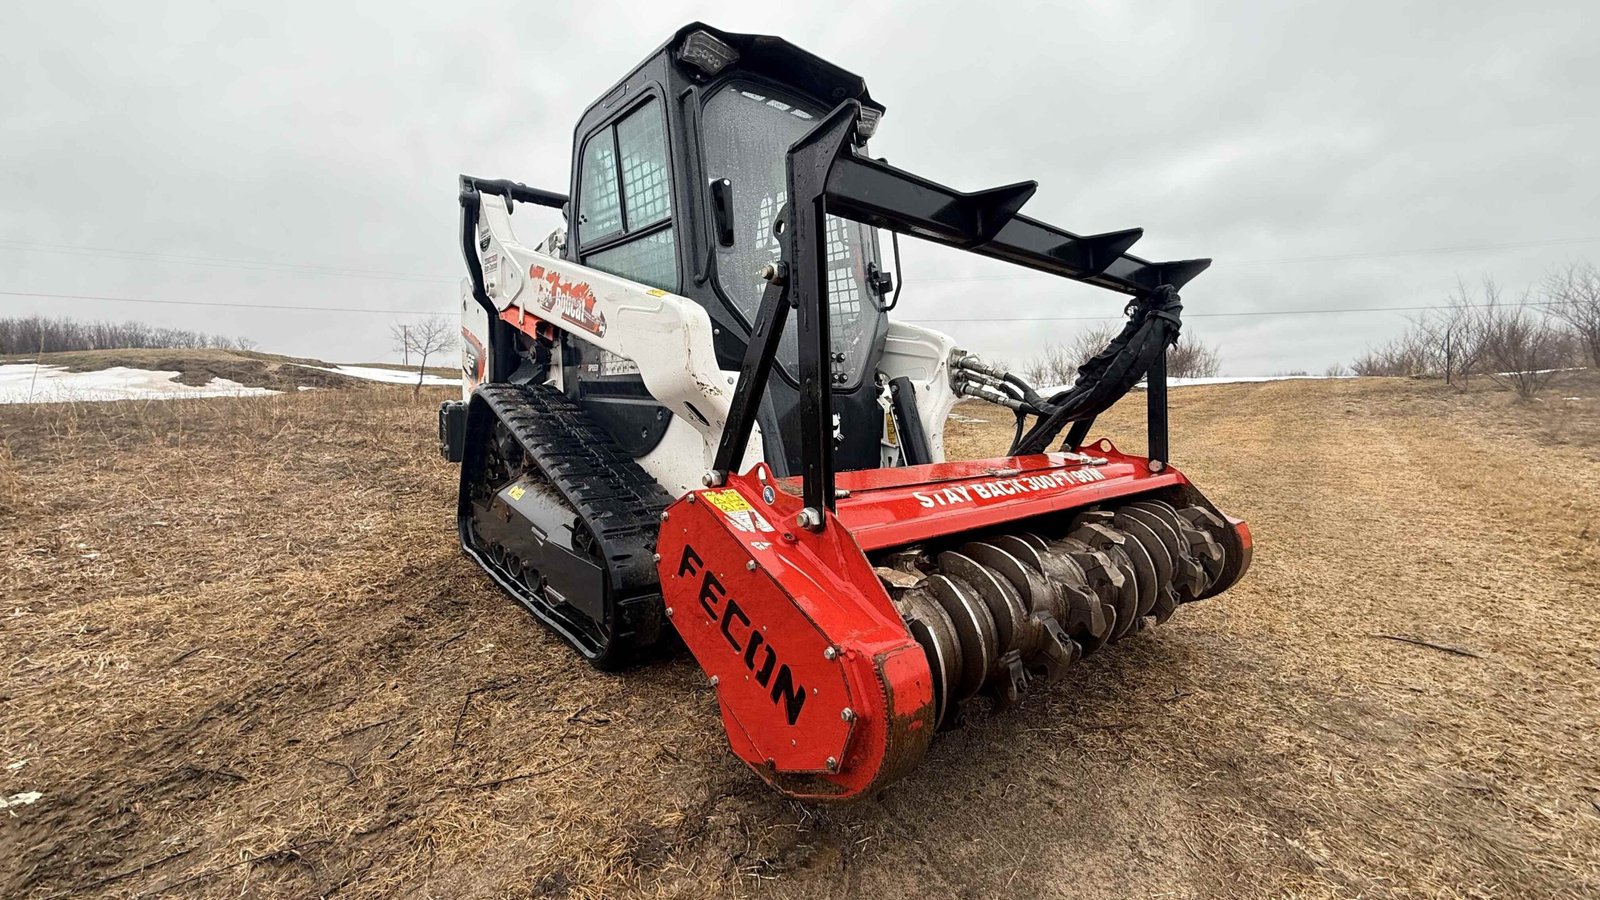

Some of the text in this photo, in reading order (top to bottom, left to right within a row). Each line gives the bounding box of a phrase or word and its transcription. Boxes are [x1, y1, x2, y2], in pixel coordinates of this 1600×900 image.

[555, 287, 586, 322] Bobcat
[914, 487, 973, 508] STAY
[972, 479, 1026, 500] BACK
[678, 544, 807, 726] FECON
